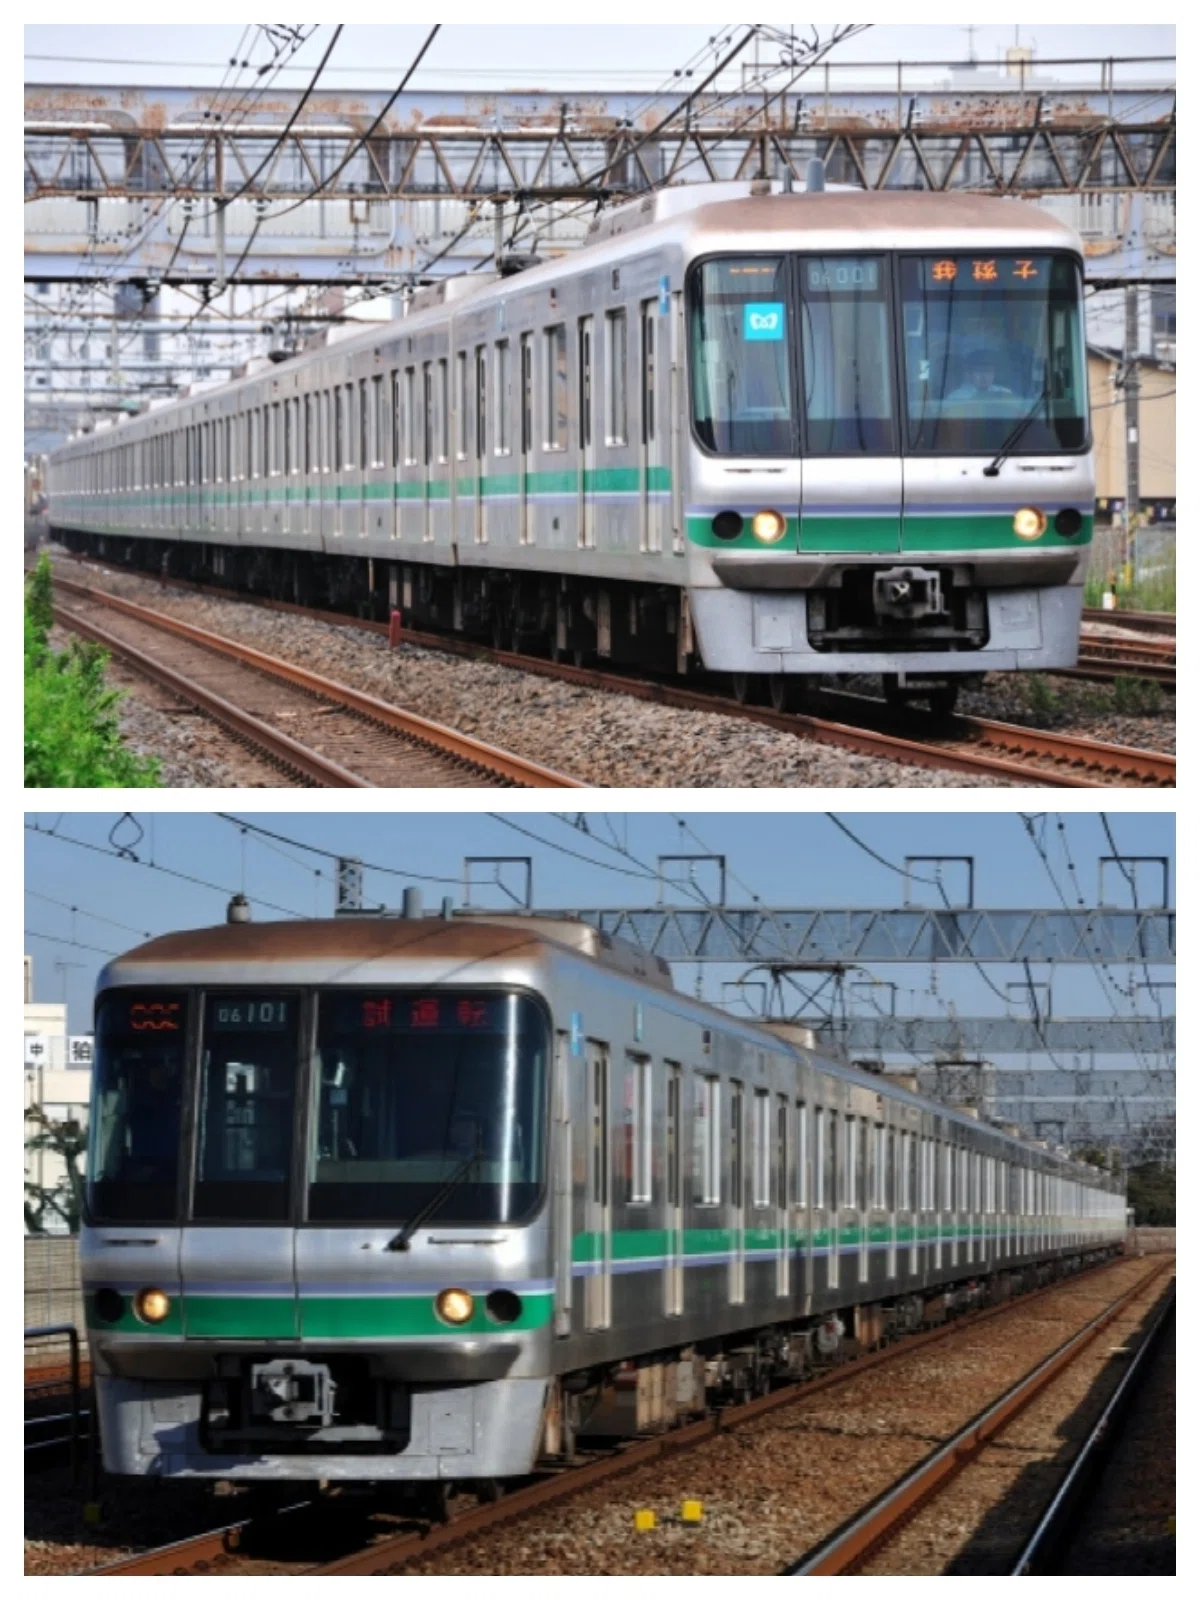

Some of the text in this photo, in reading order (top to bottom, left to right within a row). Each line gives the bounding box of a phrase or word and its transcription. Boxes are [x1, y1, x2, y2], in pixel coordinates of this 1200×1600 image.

[218, 1002, 287, 1023] 06101
[363, 1000, 488, 1028] 試運転
